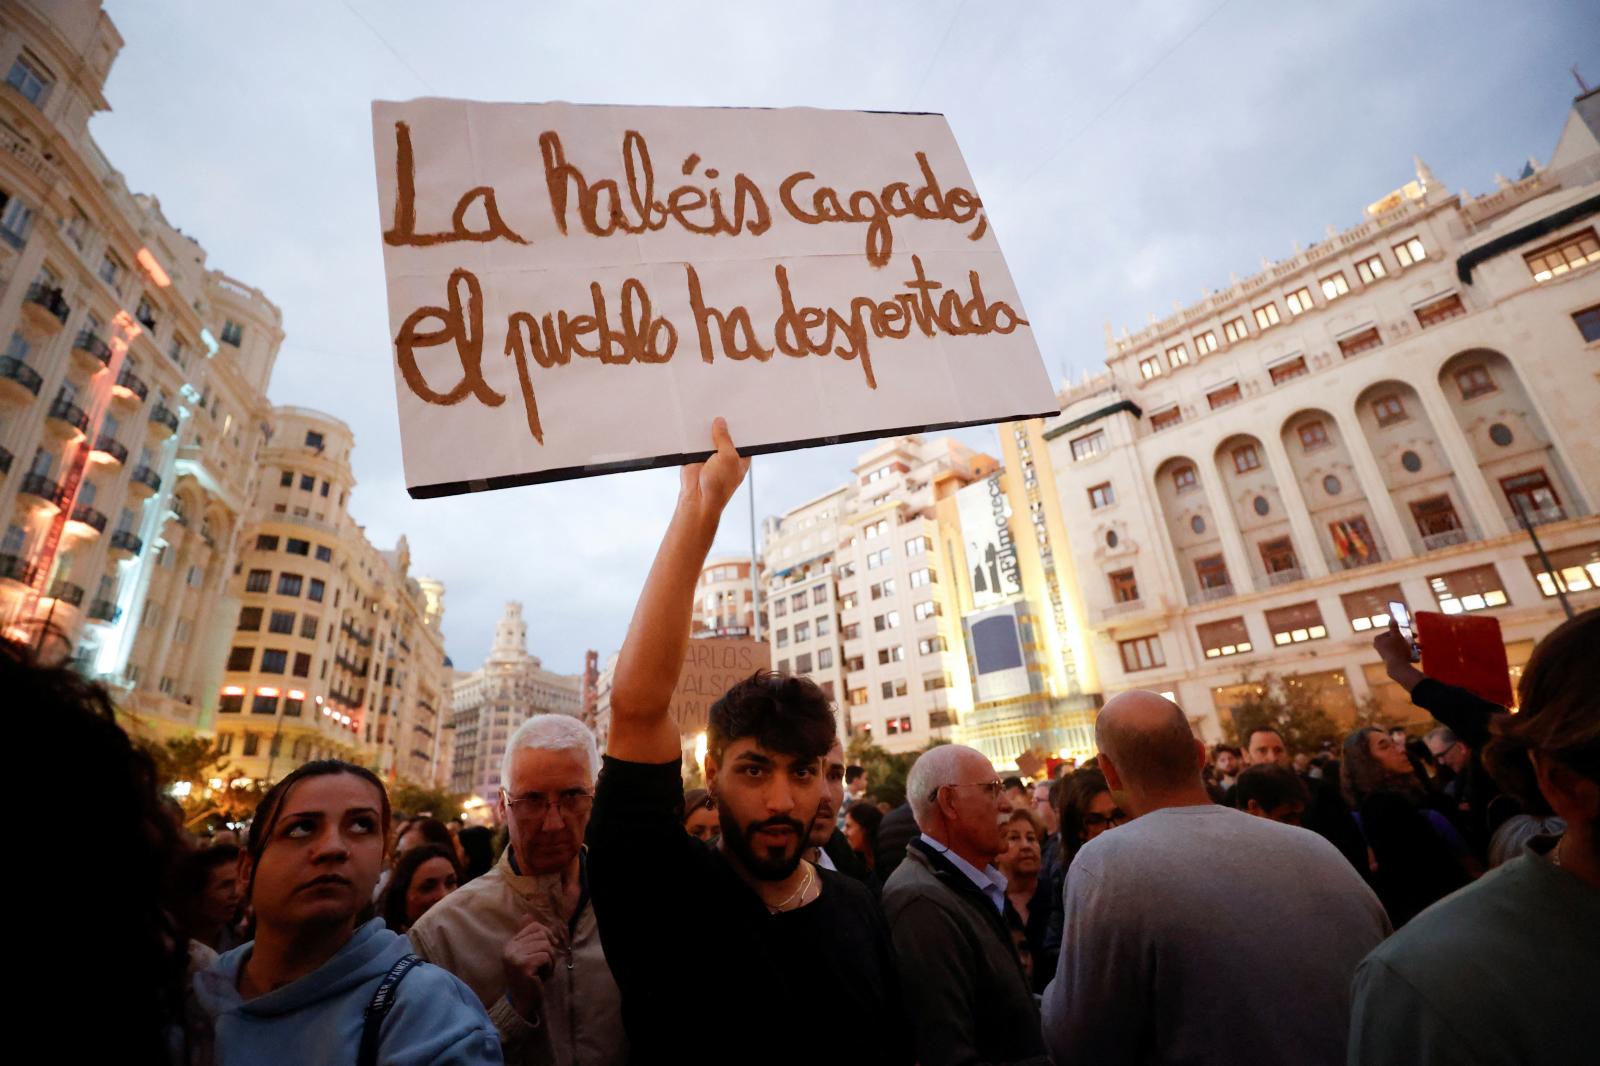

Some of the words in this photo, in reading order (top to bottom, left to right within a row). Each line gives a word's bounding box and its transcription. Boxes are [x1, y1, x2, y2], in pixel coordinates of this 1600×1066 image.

[383, 120, 531, 247] La
[538, 129, 773, 238] habéis
[778, 151, 988, 268] cagado,
[393, 266, 507, 408] el
[504, 279, 679, 446] pueblo
[684, 262, 775, 365] ha
[683, 643, 753, 671] ARLOS
